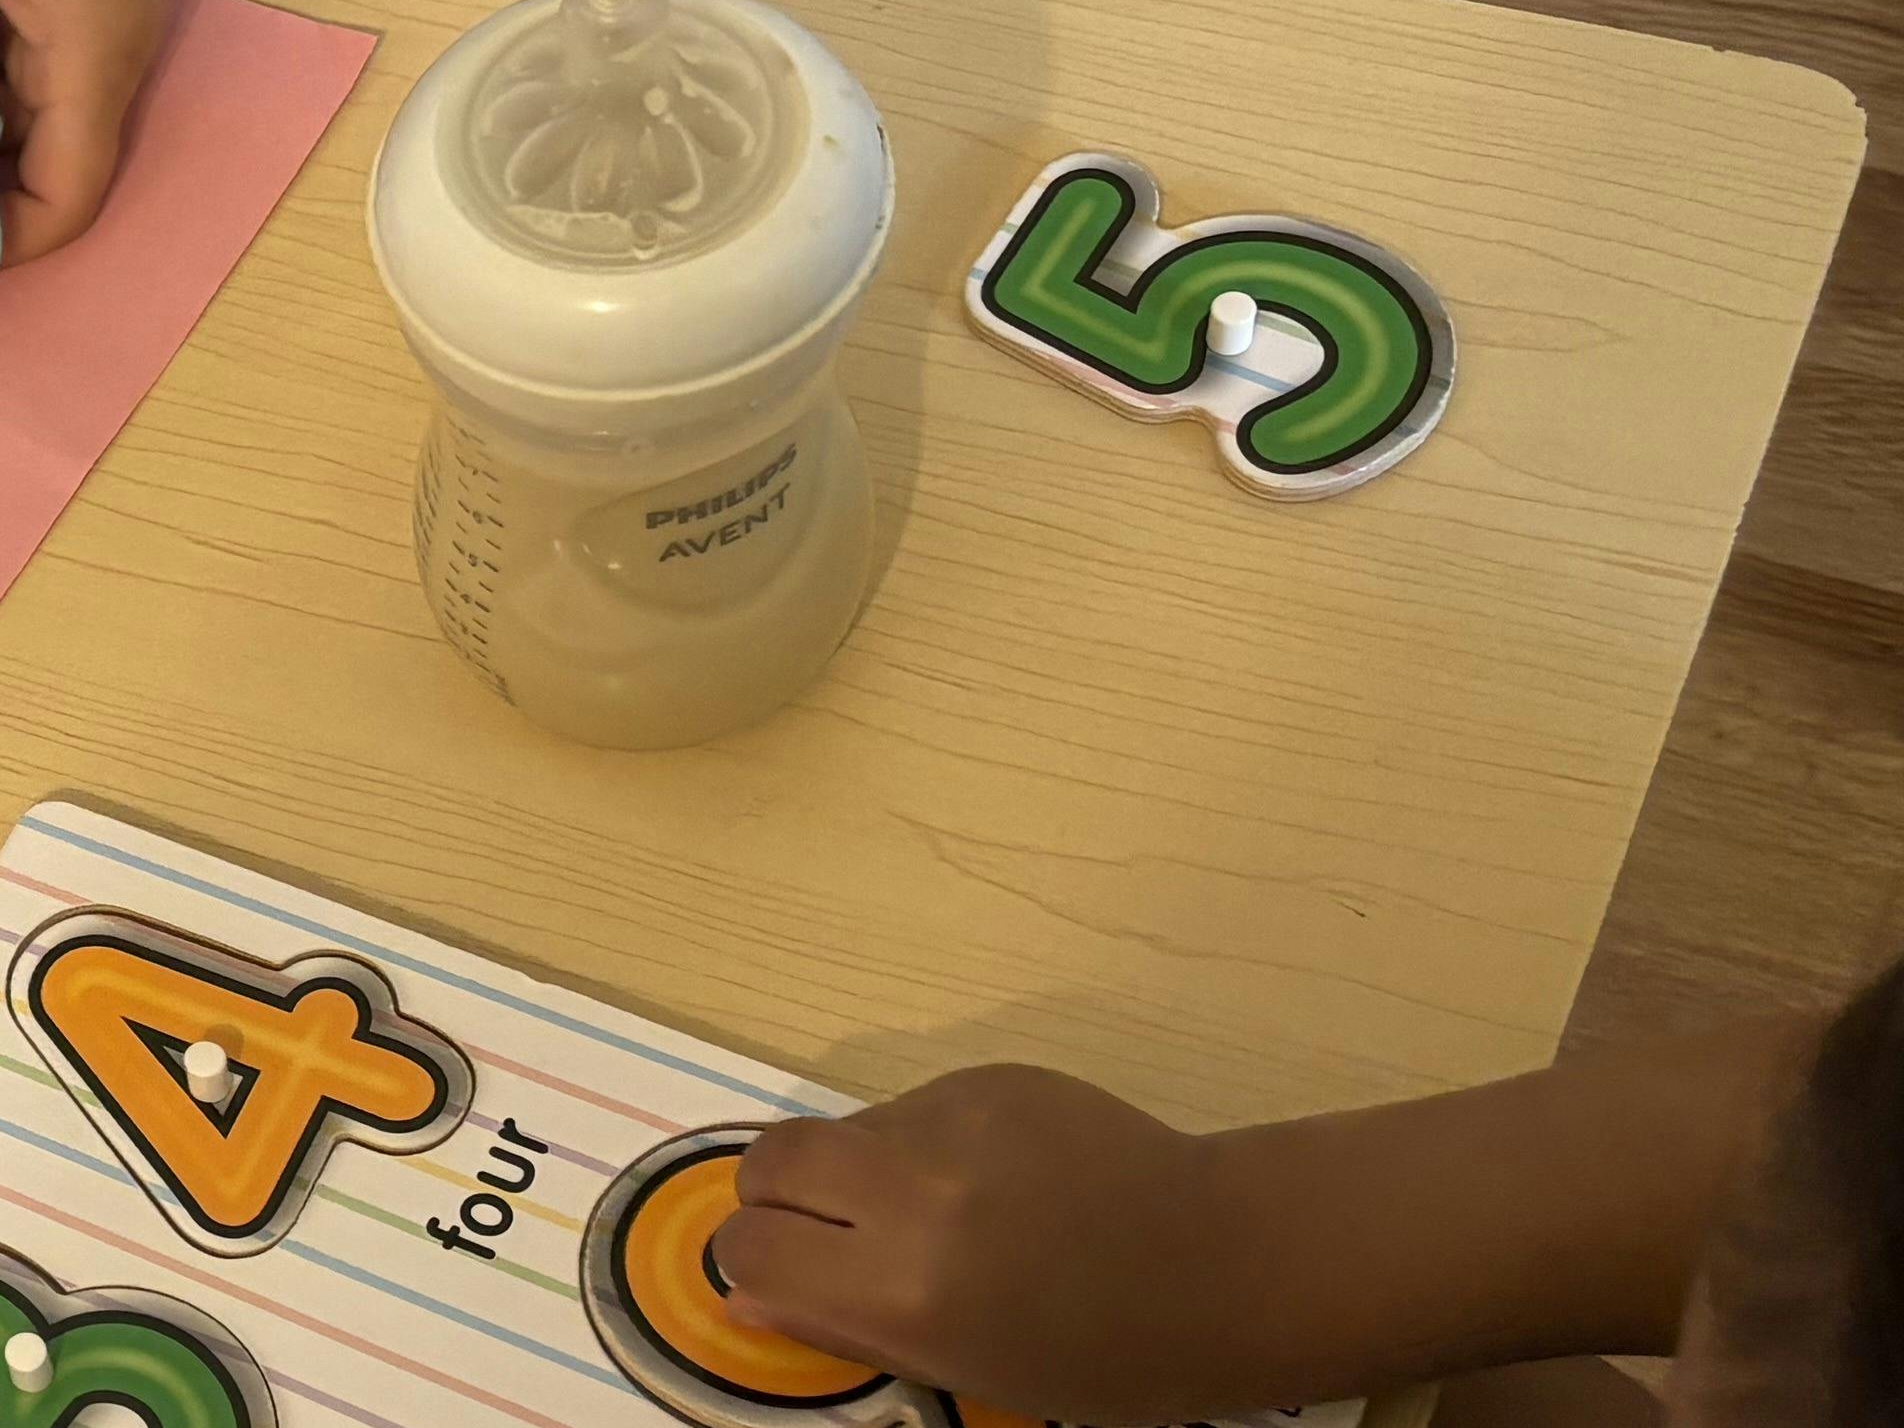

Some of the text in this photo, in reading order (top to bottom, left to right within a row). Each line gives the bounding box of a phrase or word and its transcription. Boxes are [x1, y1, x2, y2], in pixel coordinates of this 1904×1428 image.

[983, 168, 1432, 475] 5
[645, 443, 797, 529] PHILIPS
[659, 482, 791, 562] AVENT
[29, 934, 454, 1236] 4
[427, 1117, 547, 1264] four
